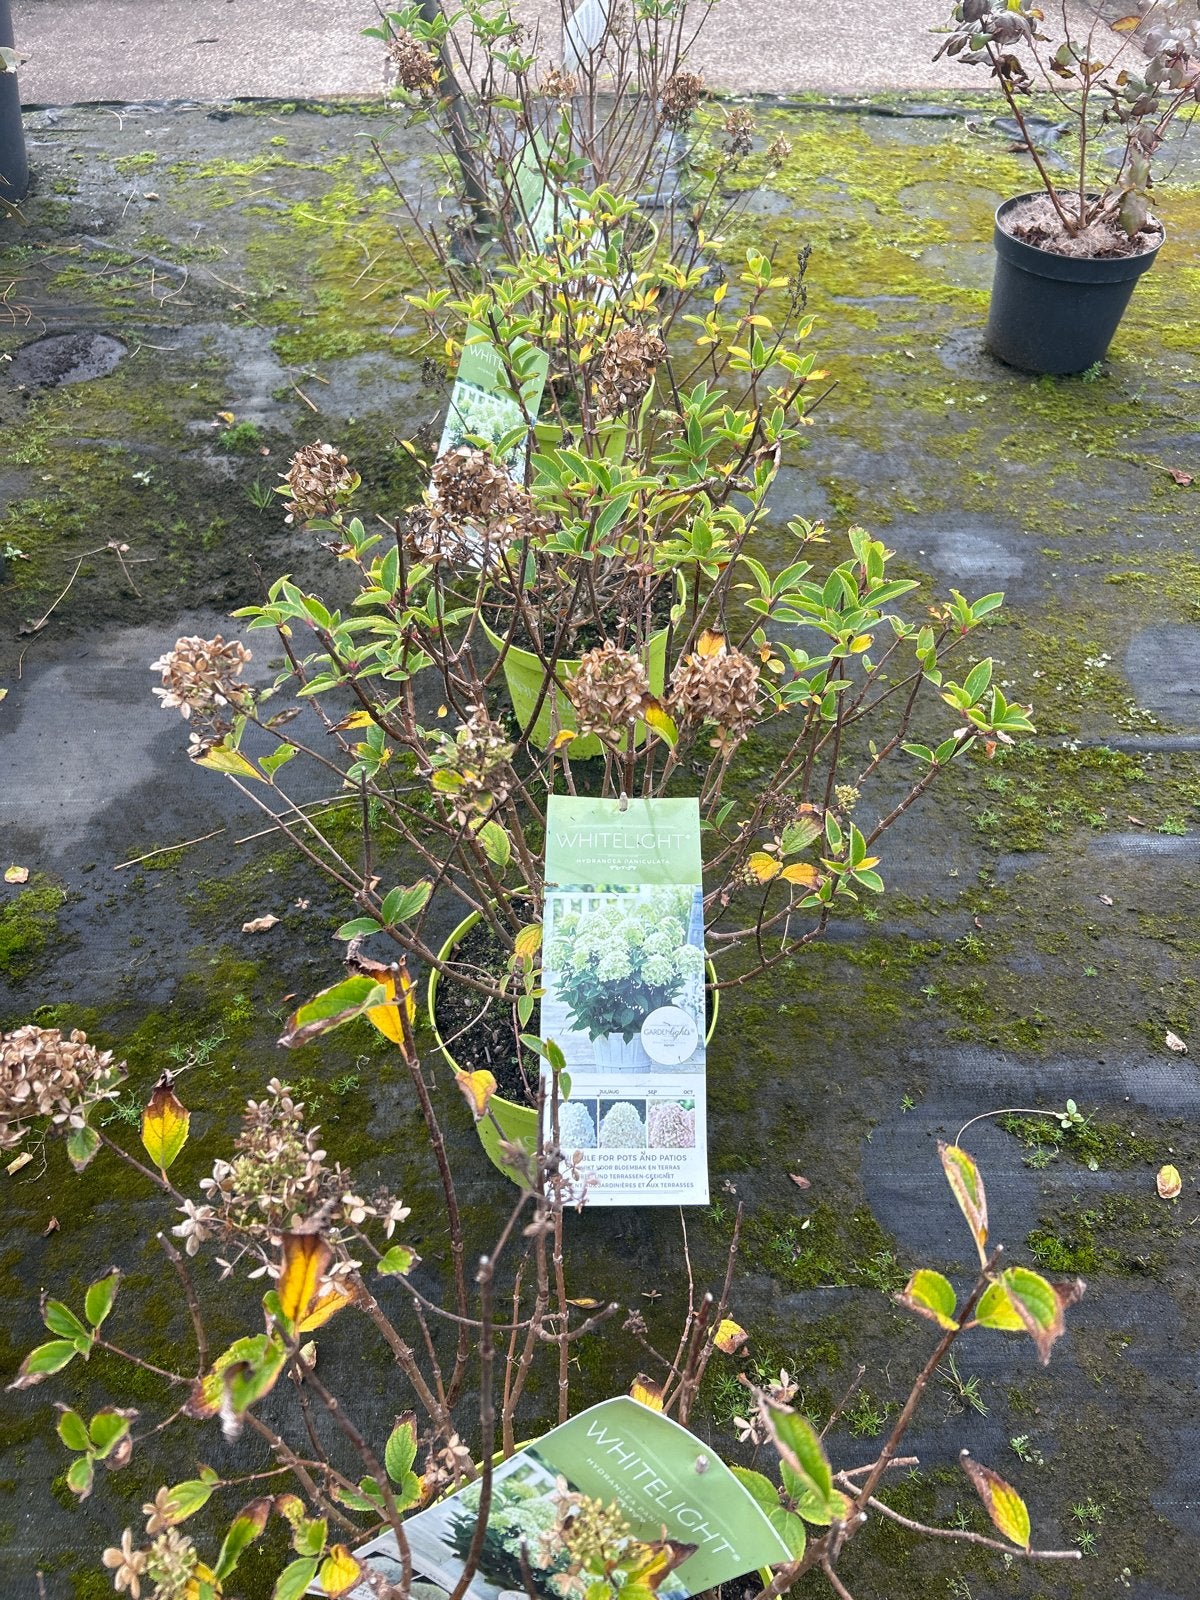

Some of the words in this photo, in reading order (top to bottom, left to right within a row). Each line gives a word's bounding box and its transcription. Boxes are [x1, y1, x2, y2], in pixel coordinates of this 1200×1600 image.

[599, 1154, 615, 1162] FOR
[617, 1154, 638, 1162] POTS
[639, 1154, 657, 1162] AND
[660, 1154, 688, 1162] PATIOS
[586, 1458, 636, 1506] HYDRANGEA
